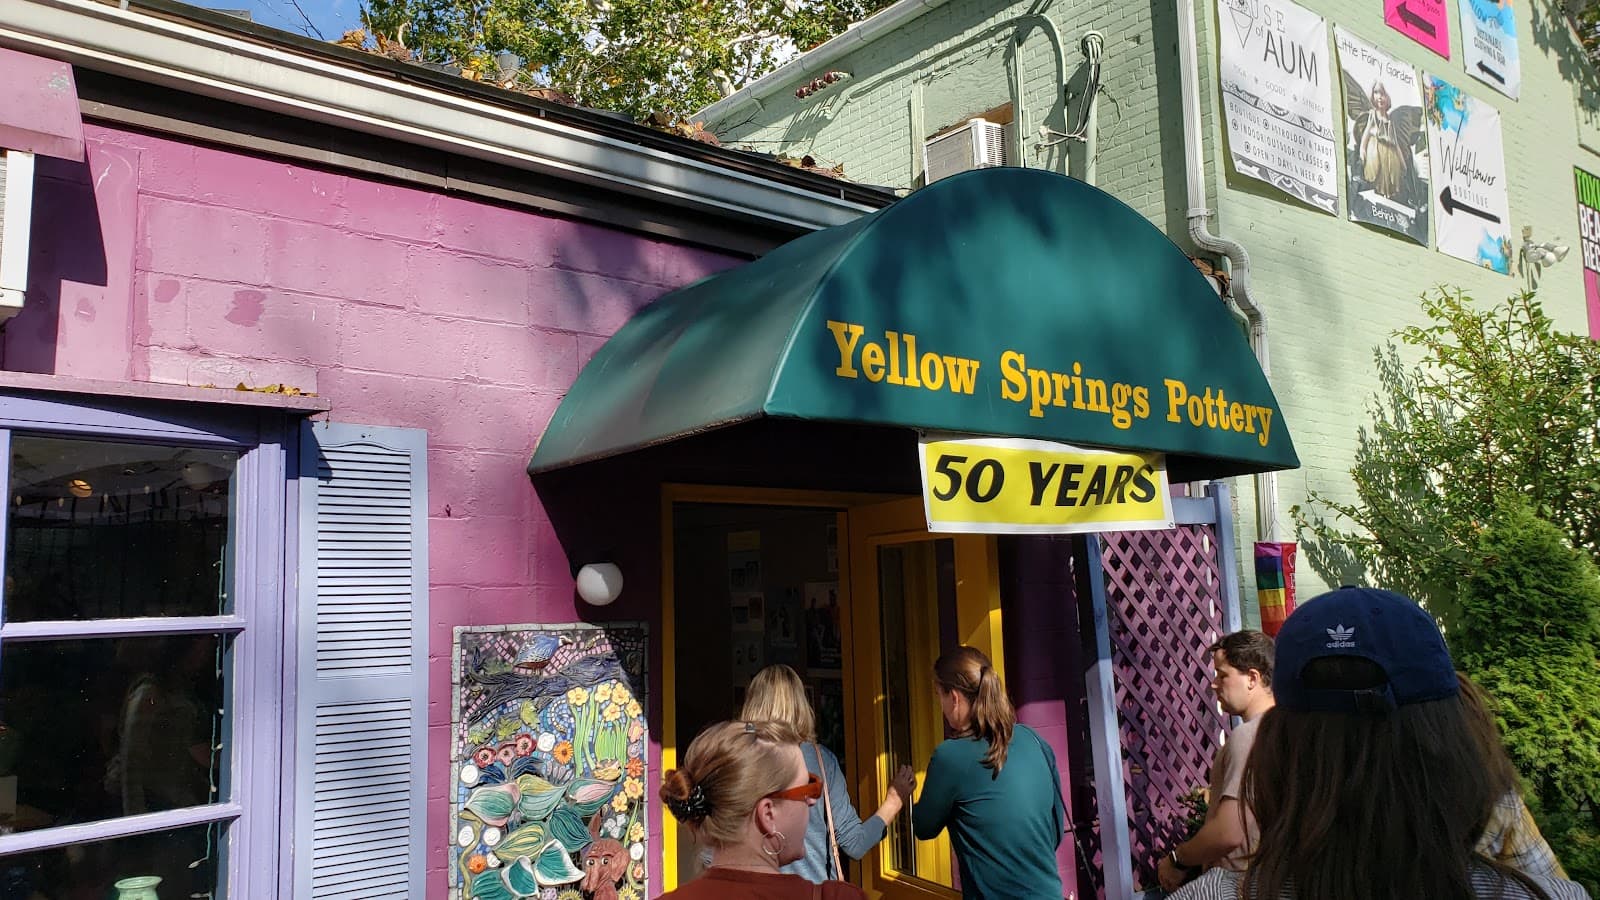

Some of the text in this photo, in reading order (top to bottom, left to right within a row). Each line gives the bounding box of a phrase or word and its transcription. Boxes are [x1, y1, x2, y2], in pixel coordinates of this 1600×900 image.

[1263, 29, 1318, 88] AUM
[1335, 33, 1415, 88] Little Fairy Garden
[1229, 102, 1261, 124] BOUTIQUE
[1271, 123, 1307, 147] ASTROLOGY
[1439, 110, 1496, 188] Wildflower
[1252, 145, 1270, 161] OPEN
[1277, 155, 1295, 172] DAYS
[1300, 167, 1317, 184] WEEK
[1297, 150, 1324, 170] CLASSES
[826, 319, 1273, 447] Yellow Springs Pottery
[932, 454, 1156, 507] 50 YEARS
[1326, 639, 1356, 649] adidas
